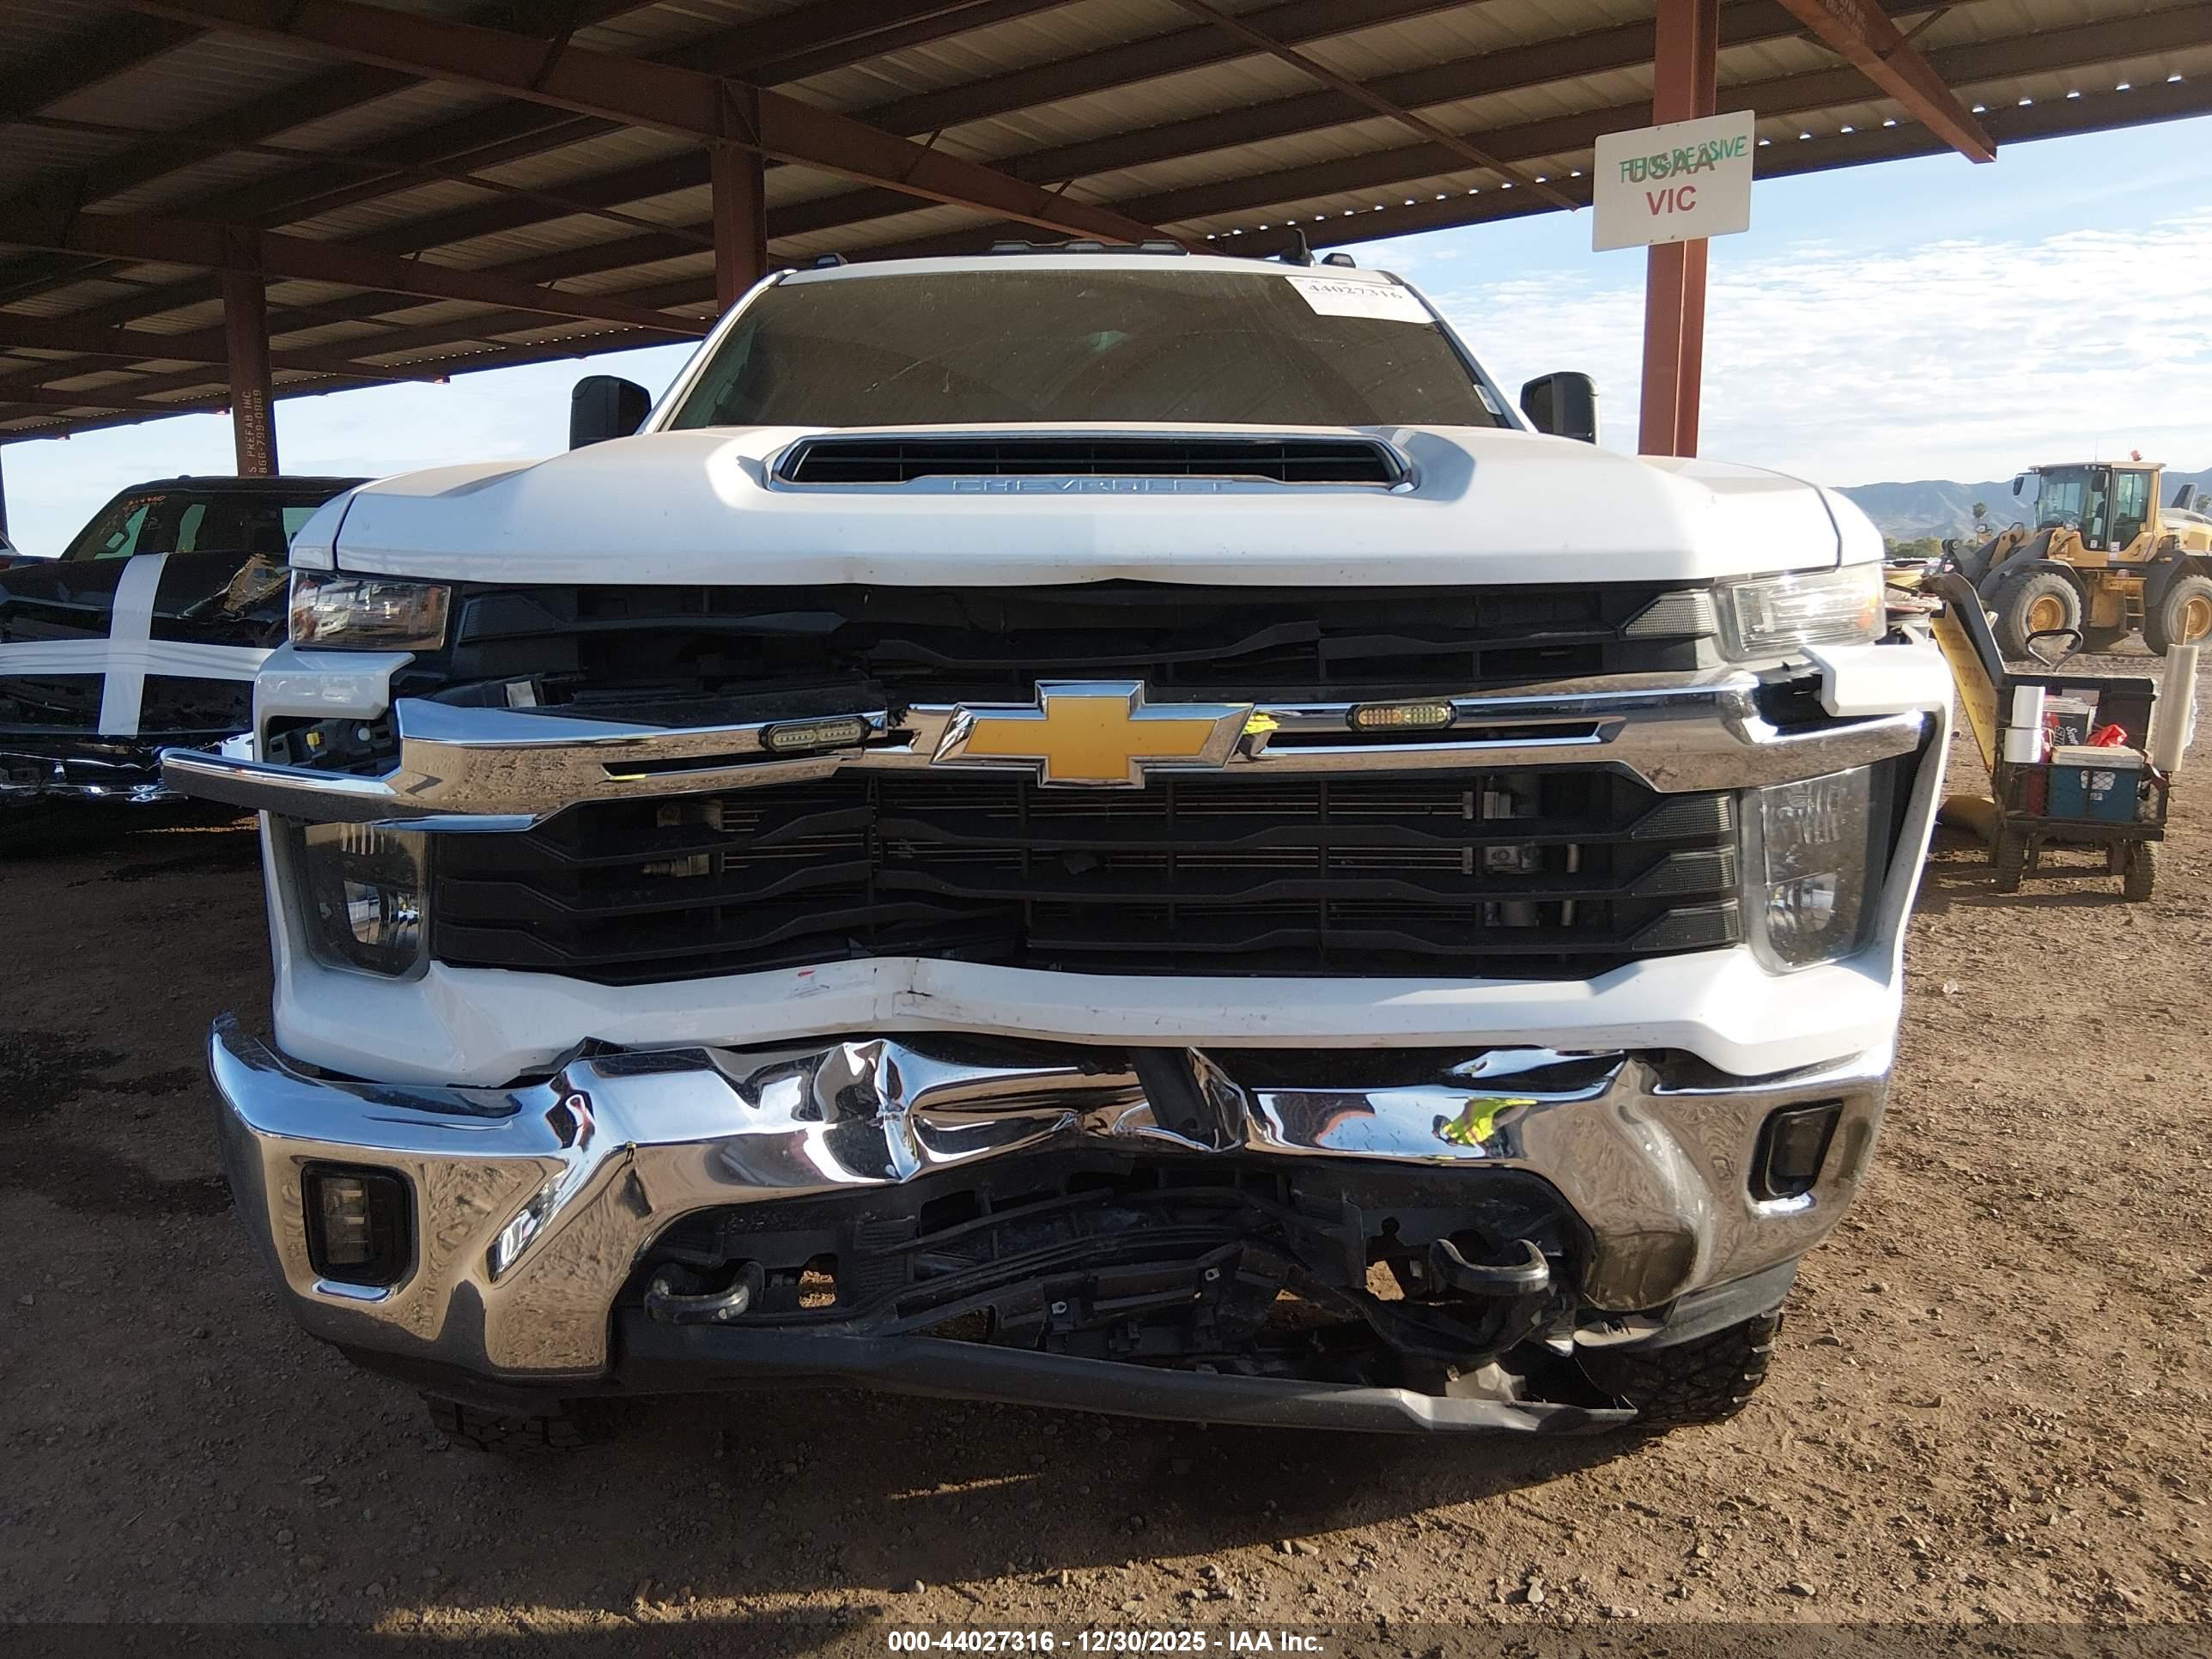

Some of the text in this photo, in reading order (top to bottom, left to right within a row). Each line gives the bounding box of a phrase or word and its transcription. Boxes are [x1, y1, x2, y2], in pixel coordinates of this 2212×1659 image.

[1645, 185, 1697, 216] VIC
[1309, 285, 1403, 299] 44027316
[242, 392, 252, 409] INC
[245, 415, 255, 457] PREFAB
[952, 479, 1231, 492] CHEVROLET
